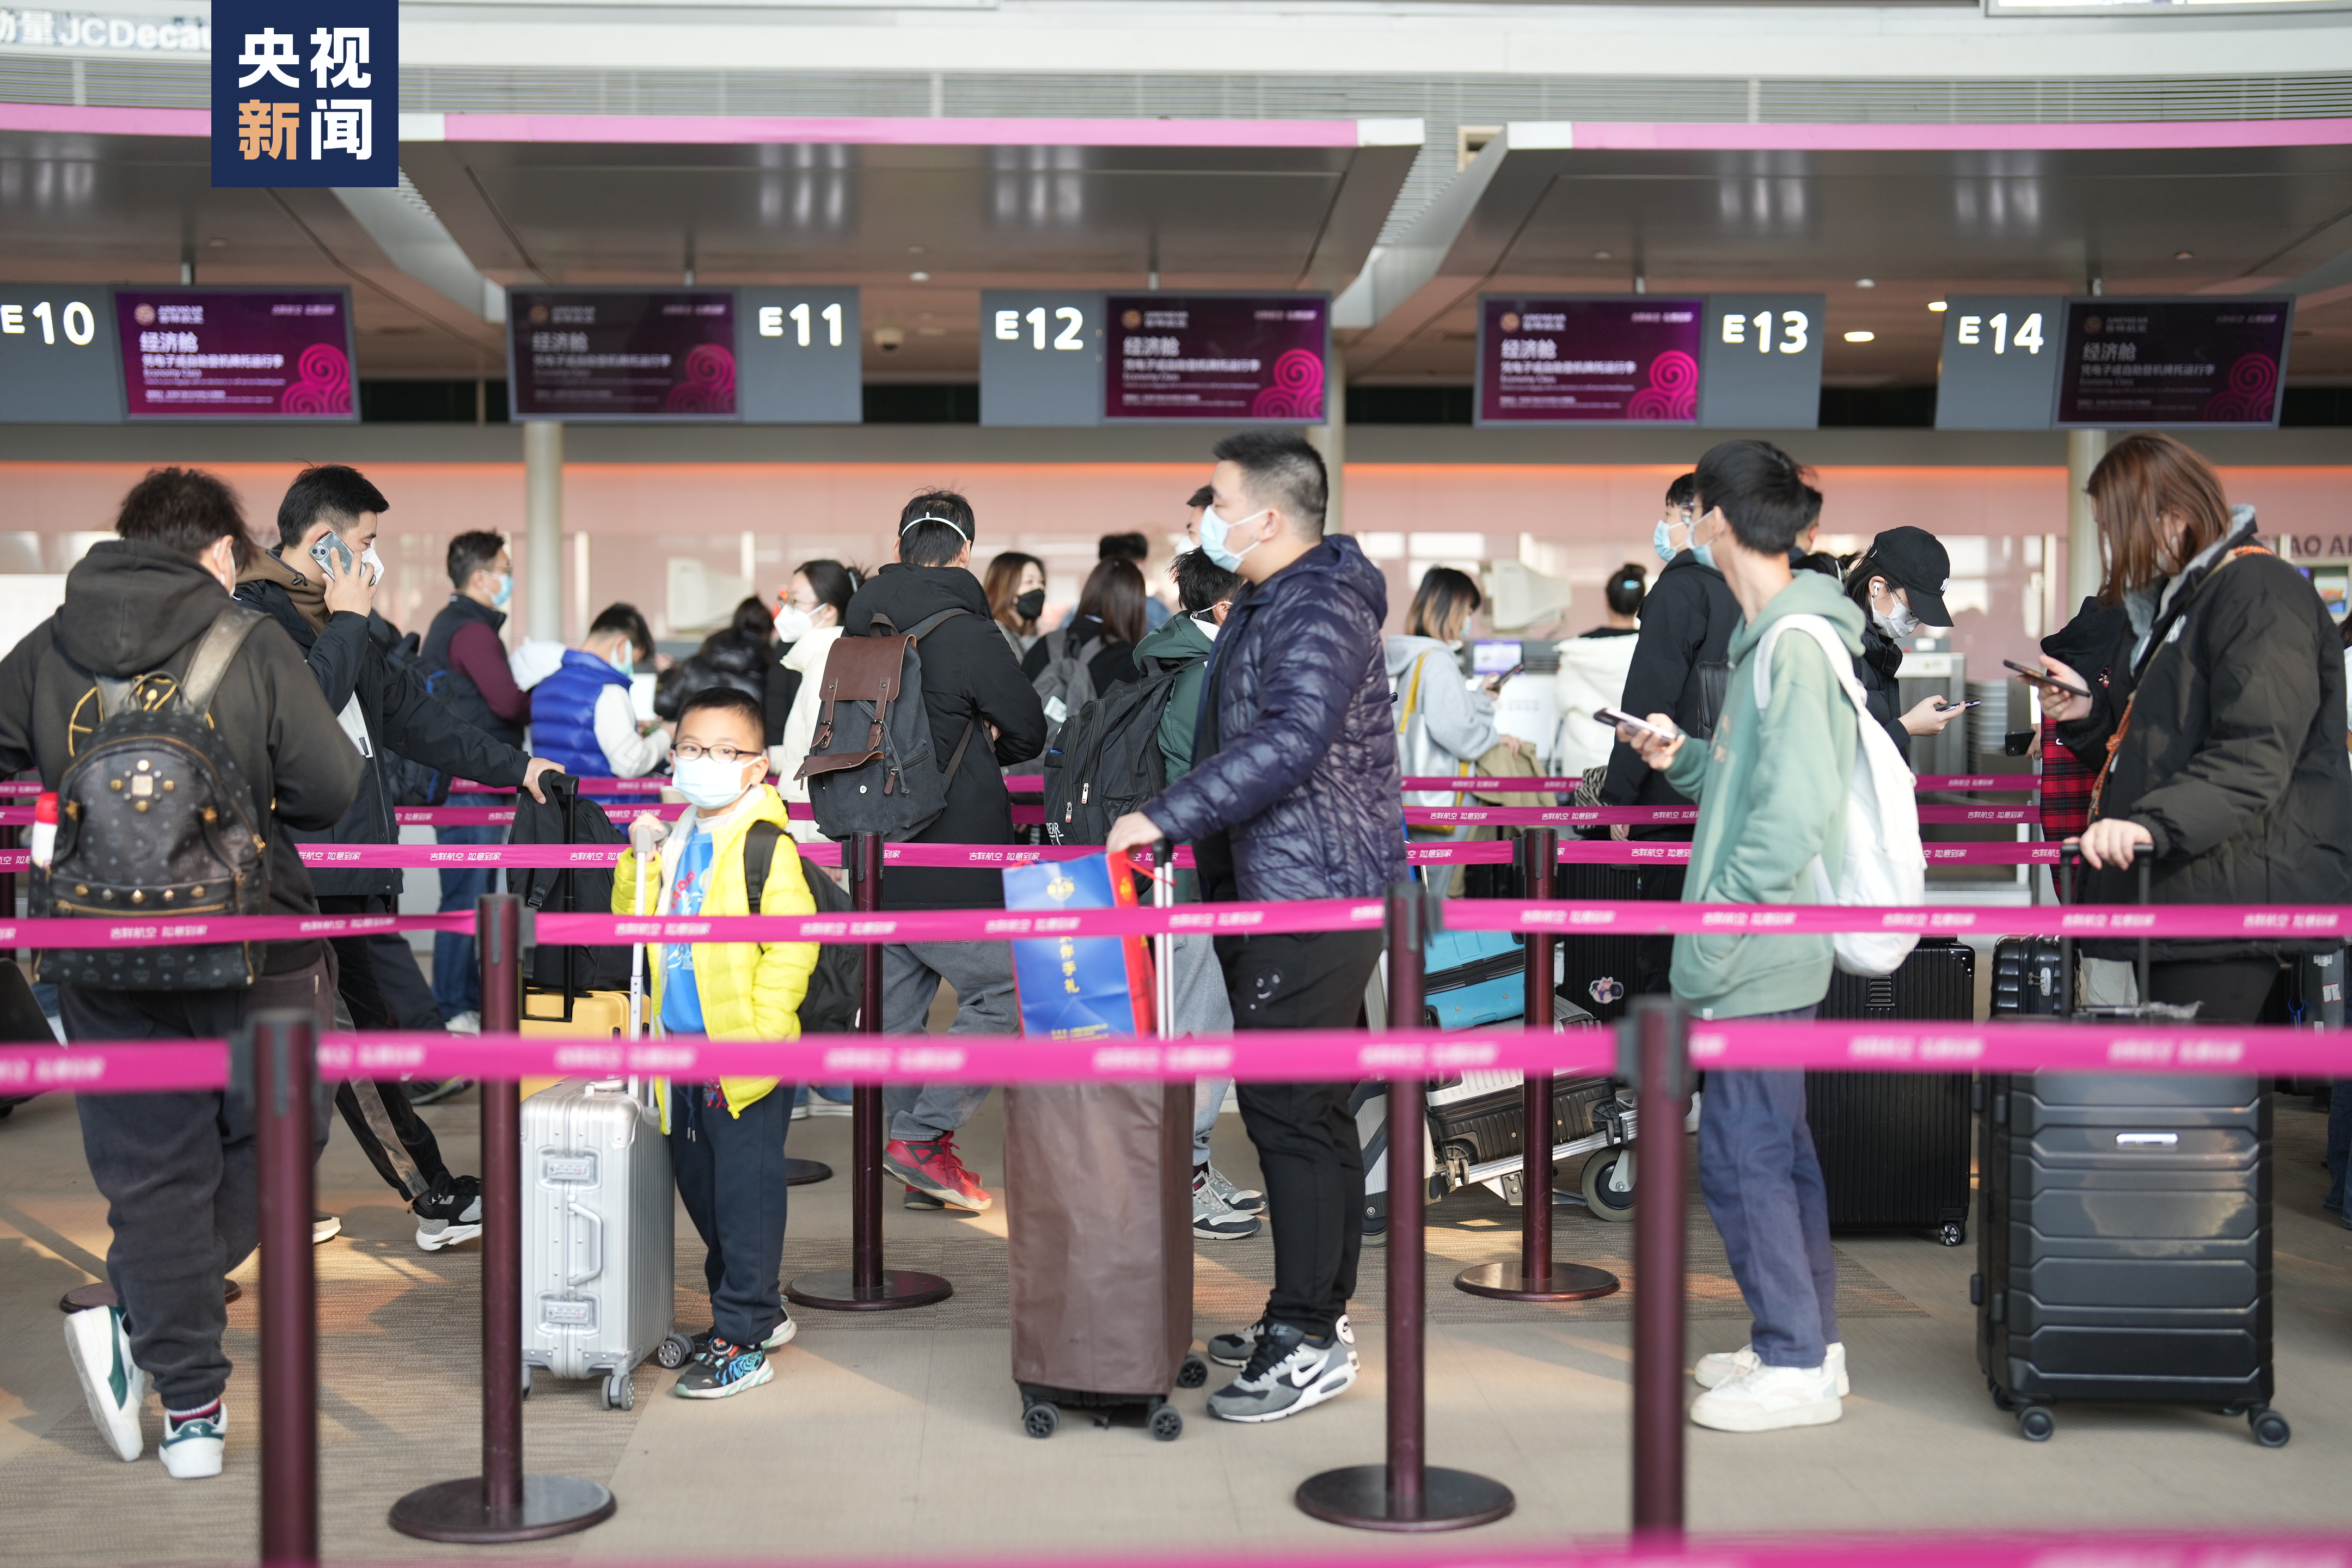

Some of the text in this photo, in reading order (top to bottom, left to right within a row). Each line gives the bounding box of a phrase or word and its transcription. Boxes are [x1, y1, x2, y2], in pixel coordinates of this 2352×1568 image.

[1, 301, 95, 346] E10
[759, 303, 843, 347] E11
[995, 307, 1084, 350] E12
[1722, 310, 1809, 354] E13
[1957, 313, 2044, 355] E14
[139, 330, 199, 353] 经济舱
[1500, 338, 1558, 359] 经济舱
[2081, 341, 2137, 362] 经济舱
[1460, 812, 1487, 820] 如意到家
[1571, 812, 1598, 820] 如意到家
[1968, 811, 1995, 819] 吉祥航空
[327, 852, 361, 860] 如意到家
[430, 853, 501, 861] 吉祥航空 如意到家
[570, 852, 604, 861] 吉祥航空
[969, 852, 1040, 861] 吉祥航空 如意到家
[1419, 849, 1453, 858] 如意到家
[1631, 848, 1664, 857] 吉祥航空
[1934, 849, 1967, 857] 如意到家
[110, 927, 157, 940] 吉祥航空
